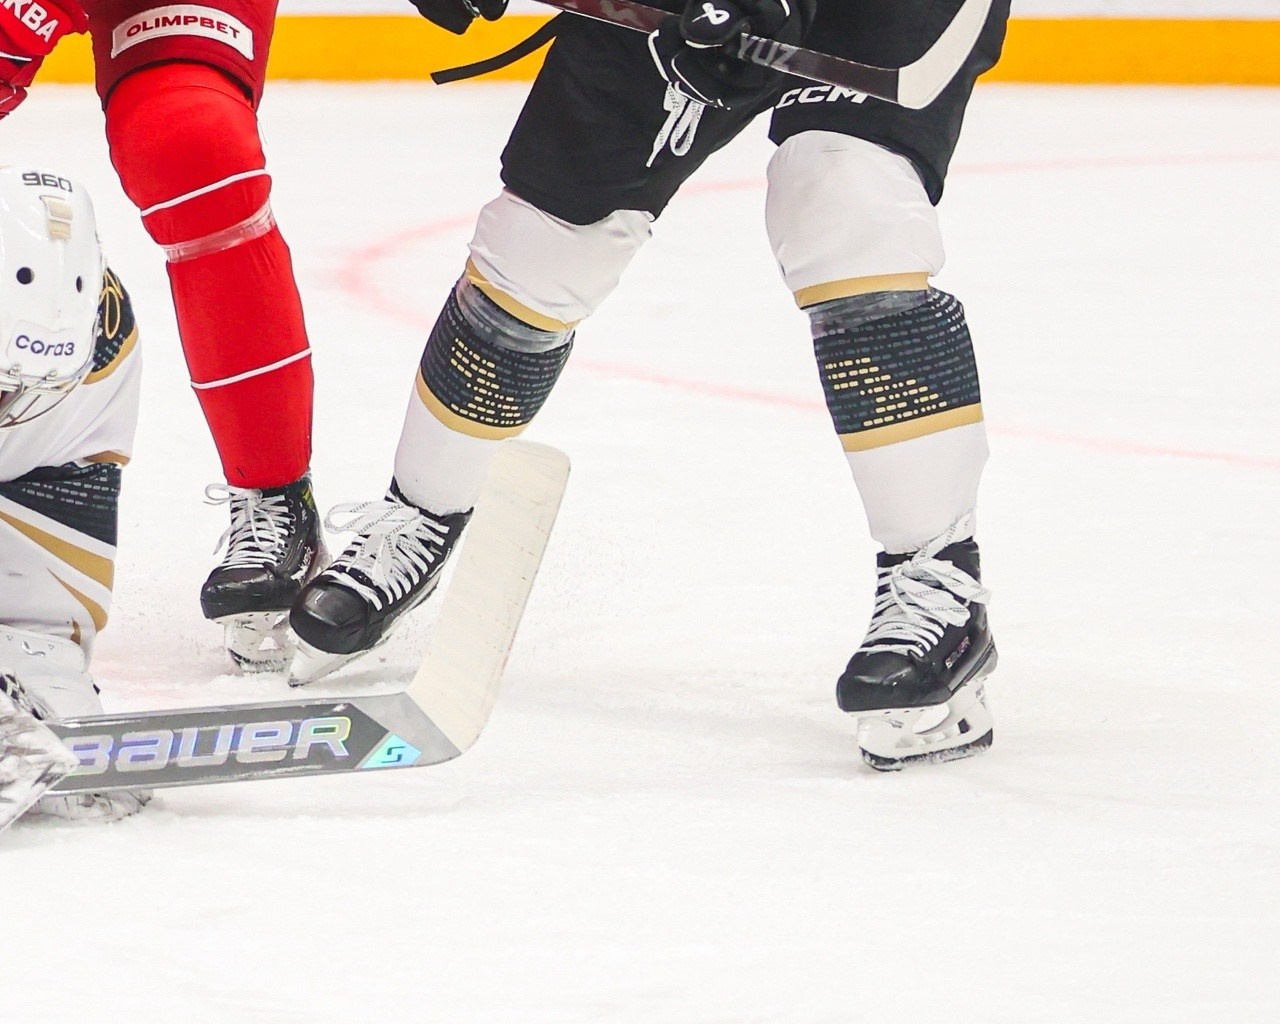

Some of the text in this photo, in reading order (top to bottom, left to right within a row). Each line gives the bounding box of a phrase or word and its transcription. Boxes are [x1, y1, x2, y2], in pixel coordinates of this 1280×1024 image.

[126, 12, 241, 40] OLIMPBET
[776, 85, 869, 110] CCM
[15, 334, 75, 357] согаз
